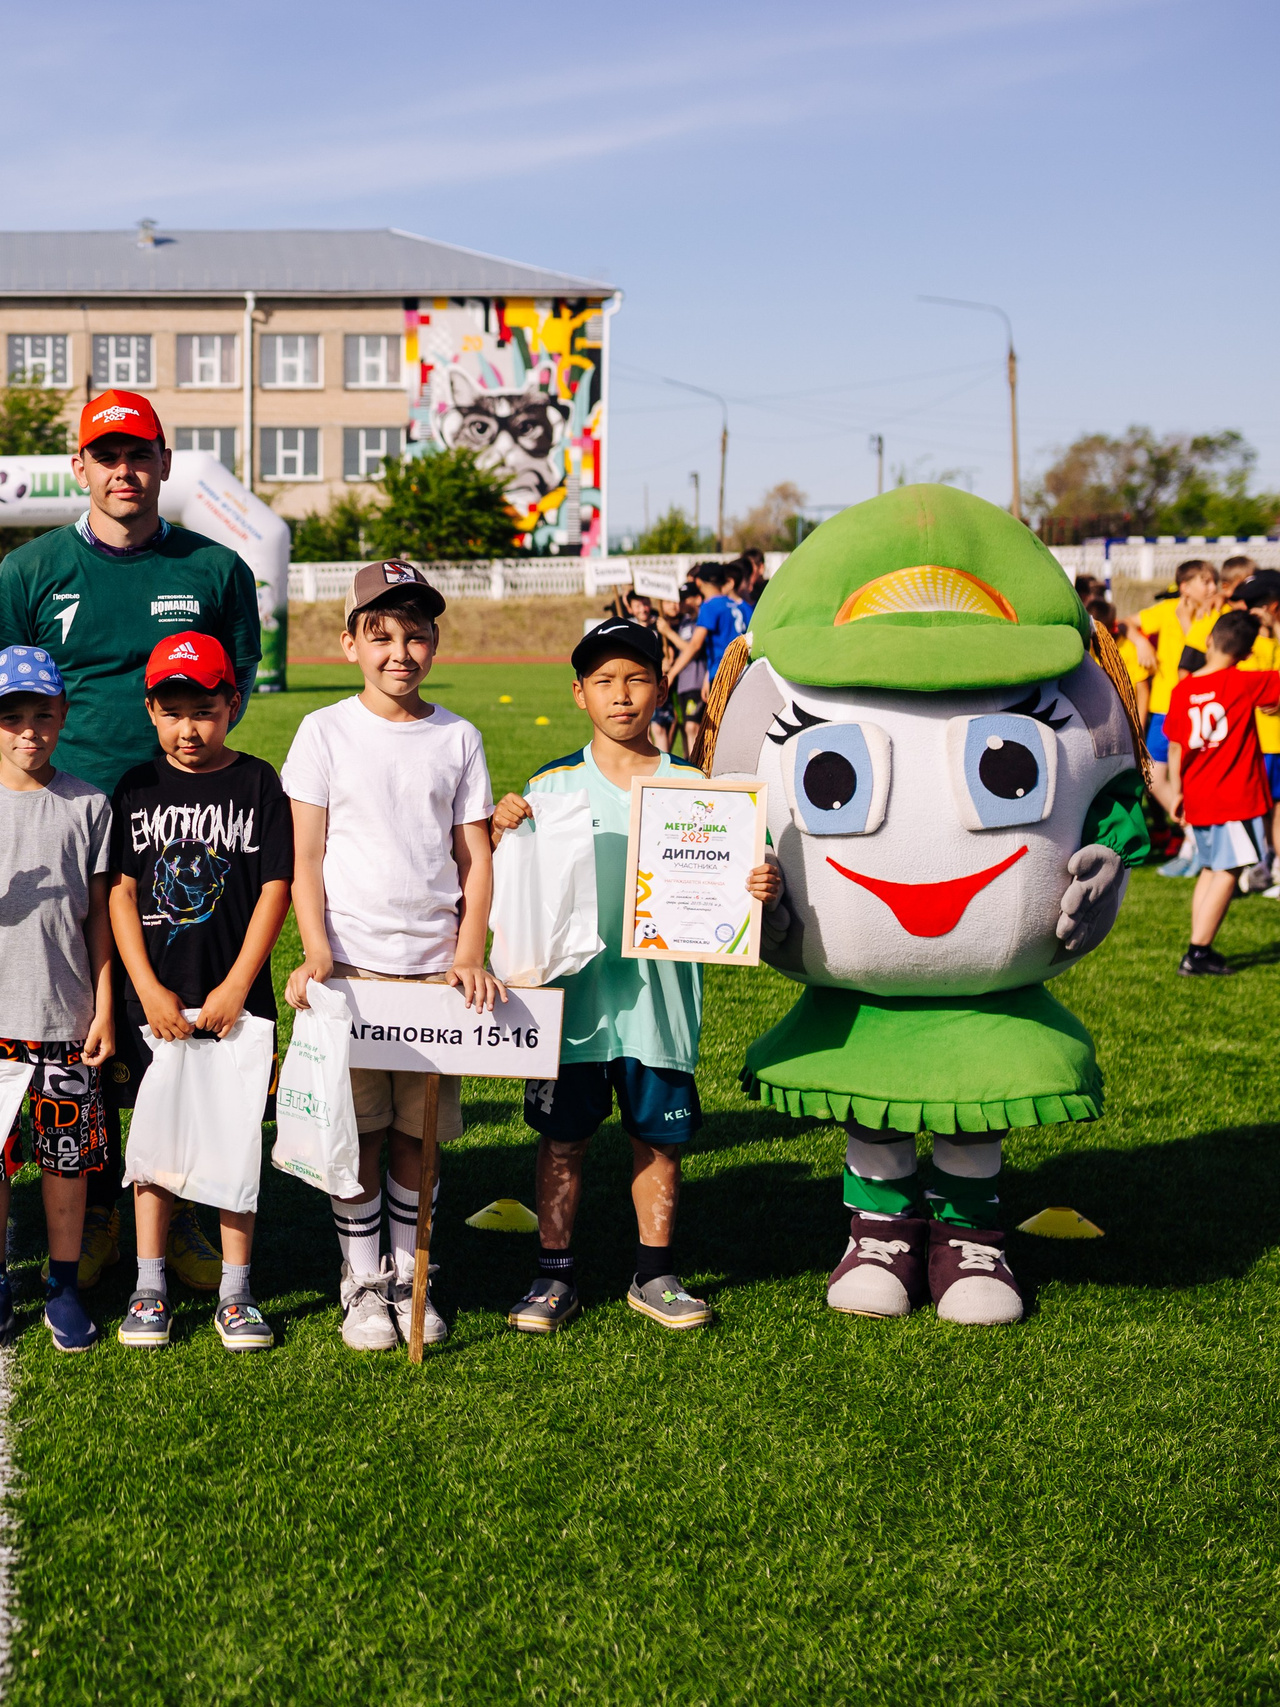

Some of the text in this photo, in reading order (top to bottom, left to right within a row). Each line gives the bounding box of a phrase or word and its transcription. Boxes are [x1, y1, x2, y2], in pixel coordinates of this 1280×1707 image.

[151, 600, 200, 616] КОМАНДА
[168, 652, 198, 661] adidas
[1188, 702, 1228, 750] 10
[131, 799, 260, 854] EMOTIONAL
[681, 831, 710, 843] 2025
[662, 848, 730, 861] ДИПЛОМ
[673, 862, 718, 870] УЧАСТНИКА
[473, 1025, 539, 1049] 15-16
[664, 1107, 692, 1122] KEL
